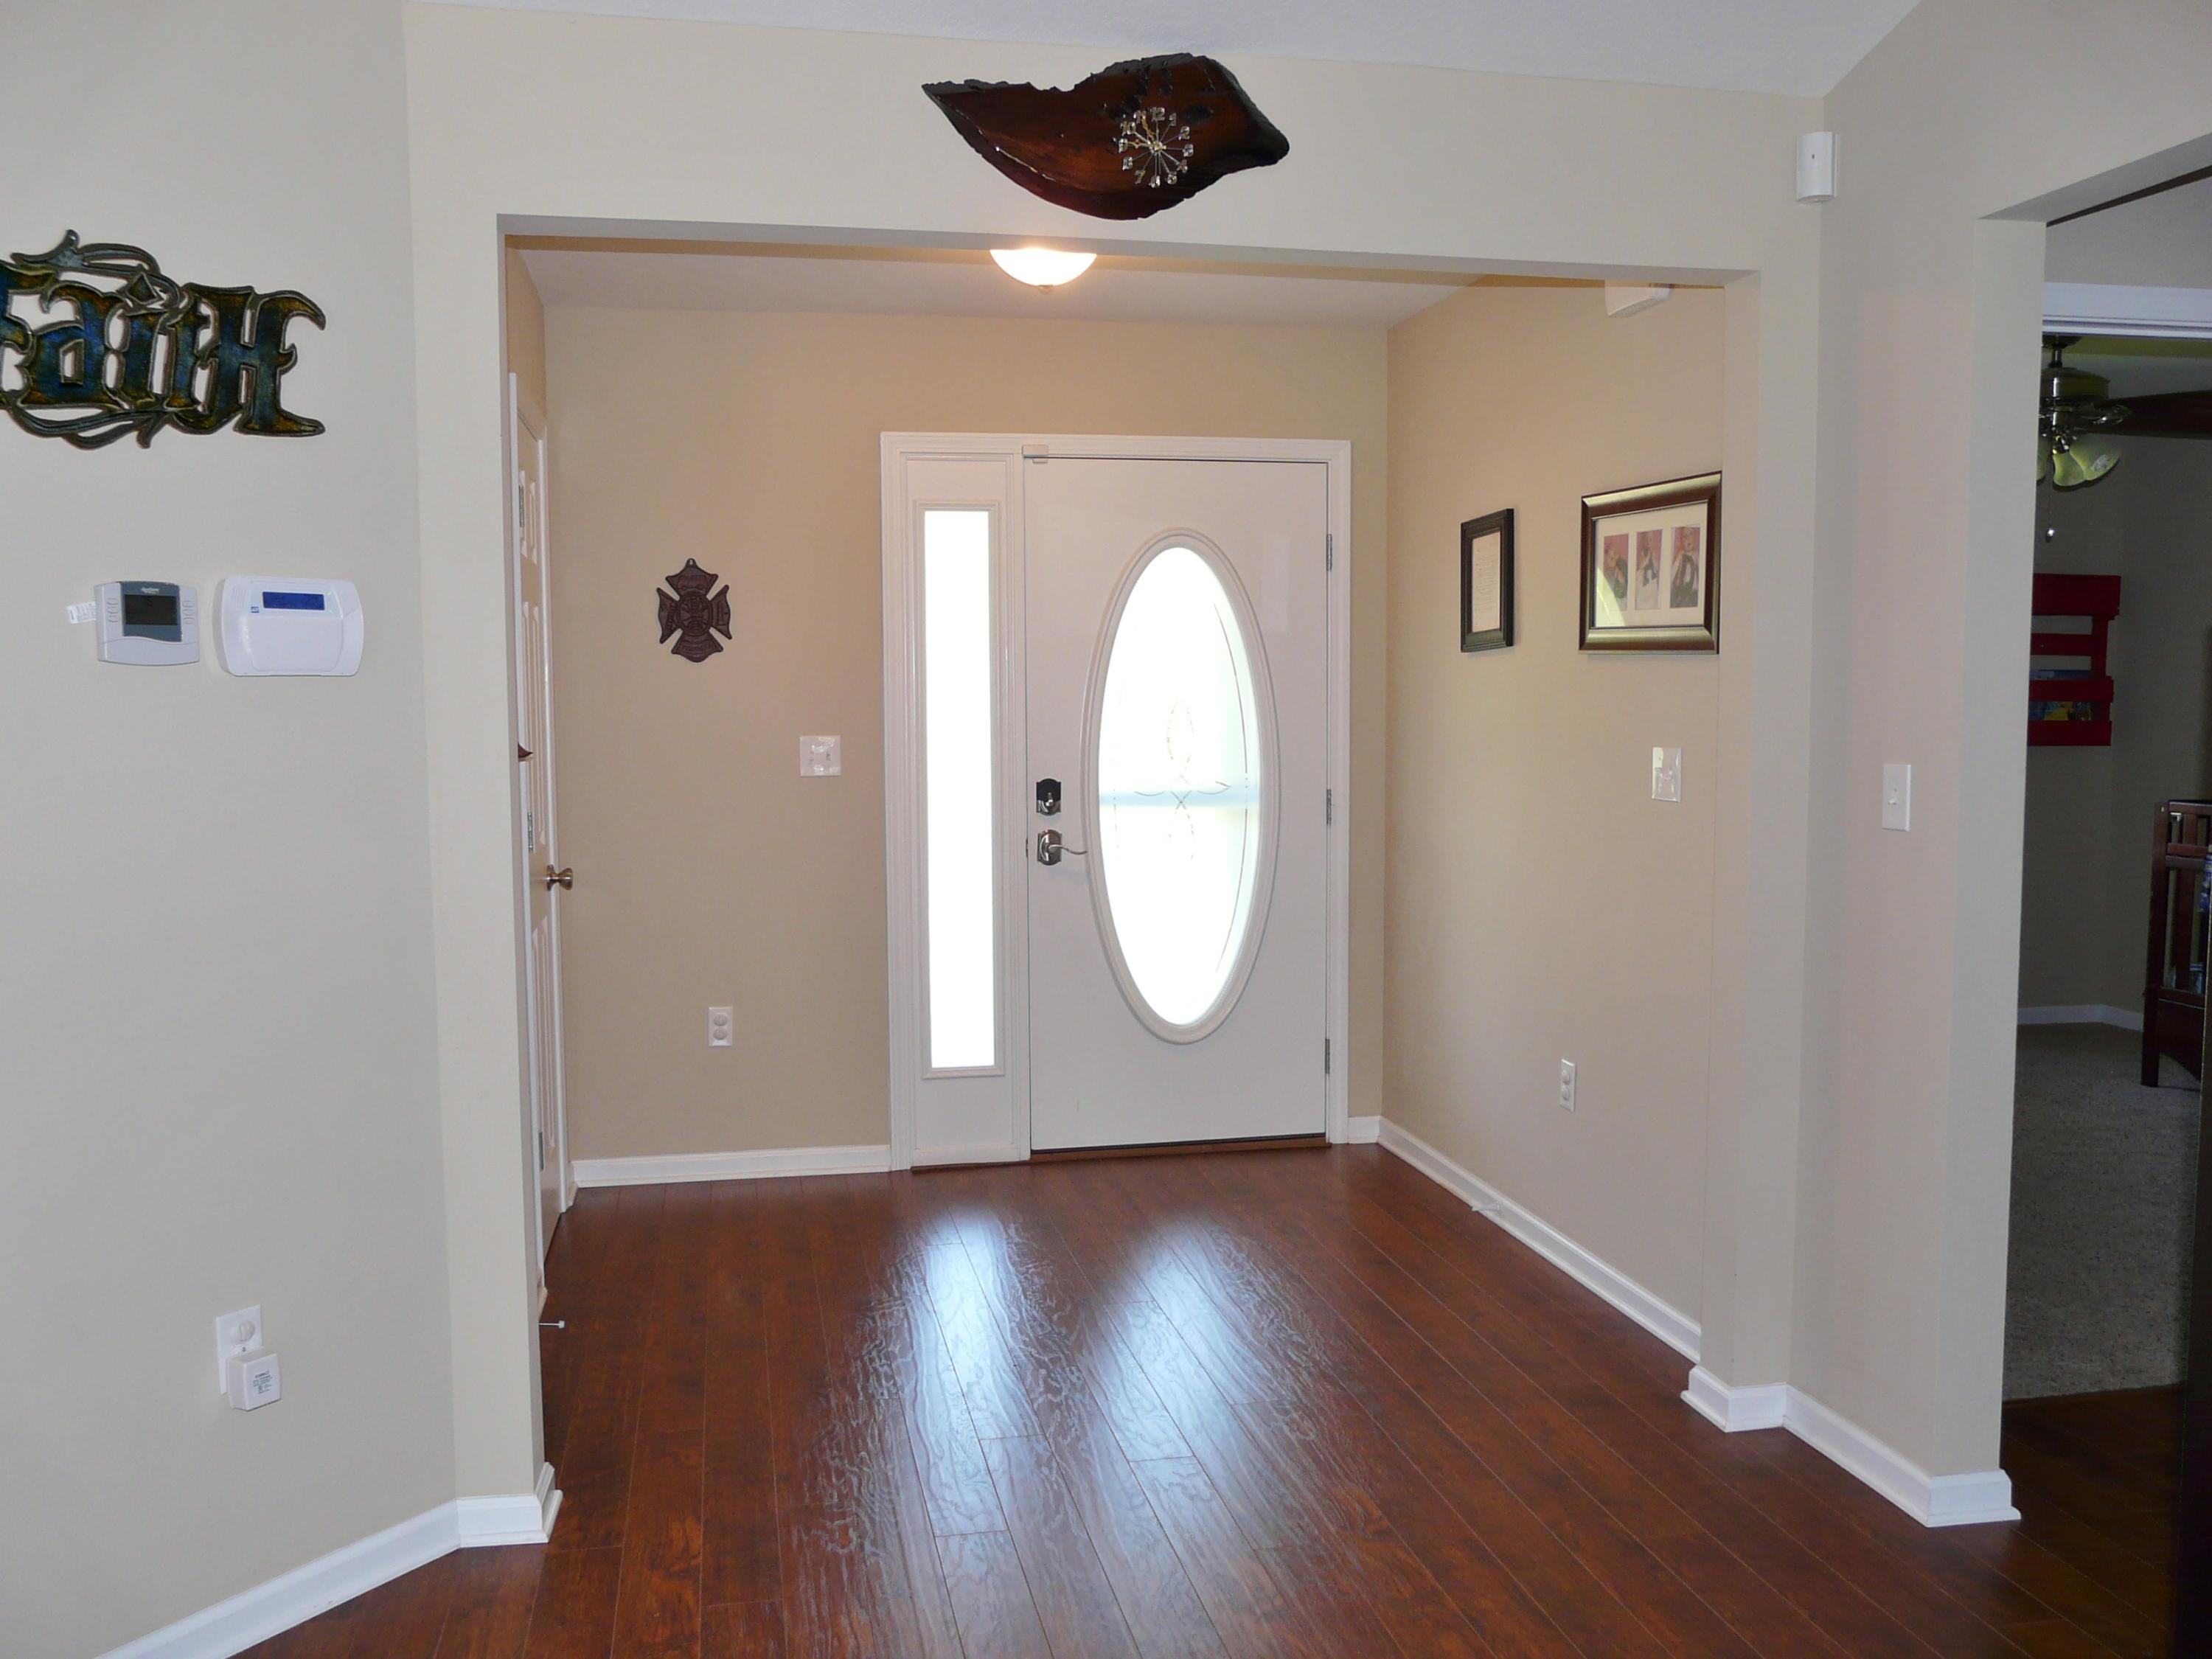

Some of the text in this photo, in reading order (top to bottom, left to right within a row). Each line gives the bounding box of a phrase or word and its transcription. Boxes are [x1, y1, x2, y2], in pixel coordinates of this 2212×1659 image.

[1151, 107, 1165, 122] 12
[1179, 126, 1189, 140] 2
[1135, 170, 1146, 184] 7
